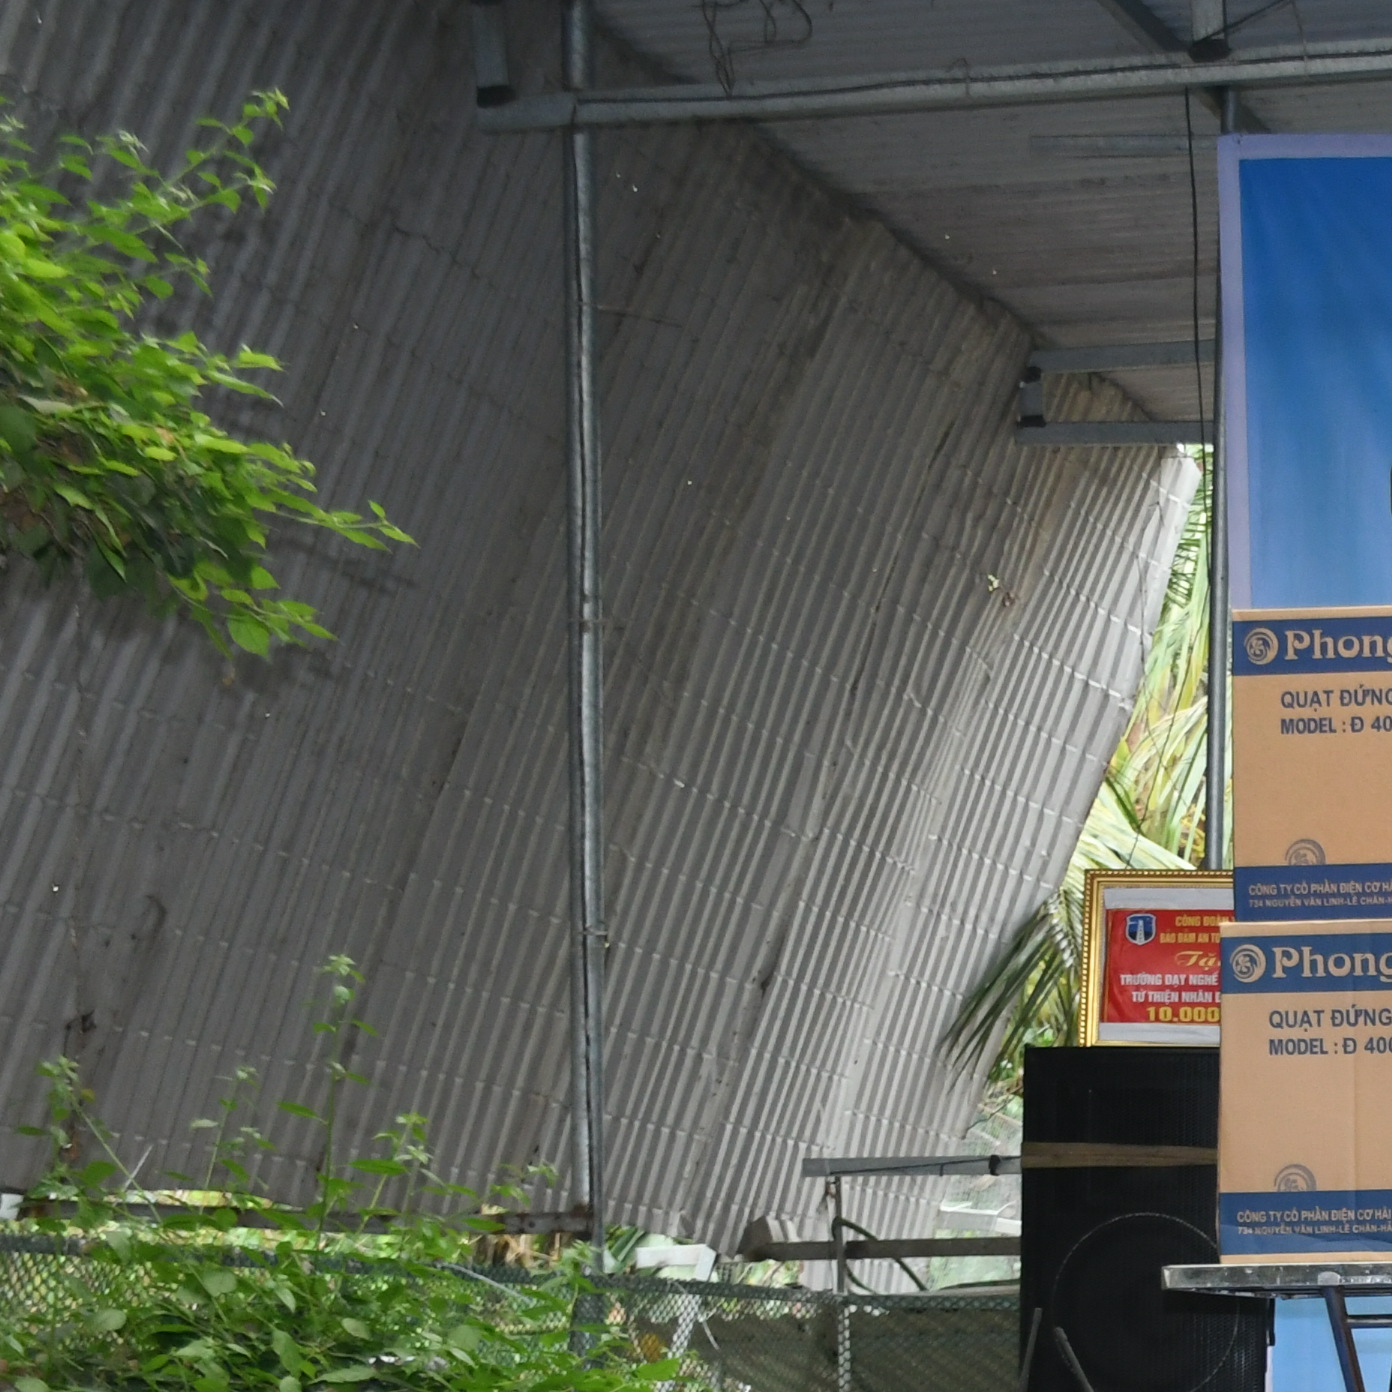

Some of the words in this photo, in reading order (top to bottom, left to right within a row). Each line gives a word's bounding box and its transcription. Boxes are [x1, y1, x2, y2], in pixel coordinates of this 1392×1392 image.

[1280, 689, 1334, 712] QUẠT
[1280, 717, 1337, 734] MODEL
[1350, 716, 1364, 732] Đ
[1248, 882, 1278, 895] CÔNG
[1279, 884, 1292, 894] TY
[1268, 1009, 1323, 1033] QUẠT
[1330, 1003, 1392, 1027] ĐỨNG
